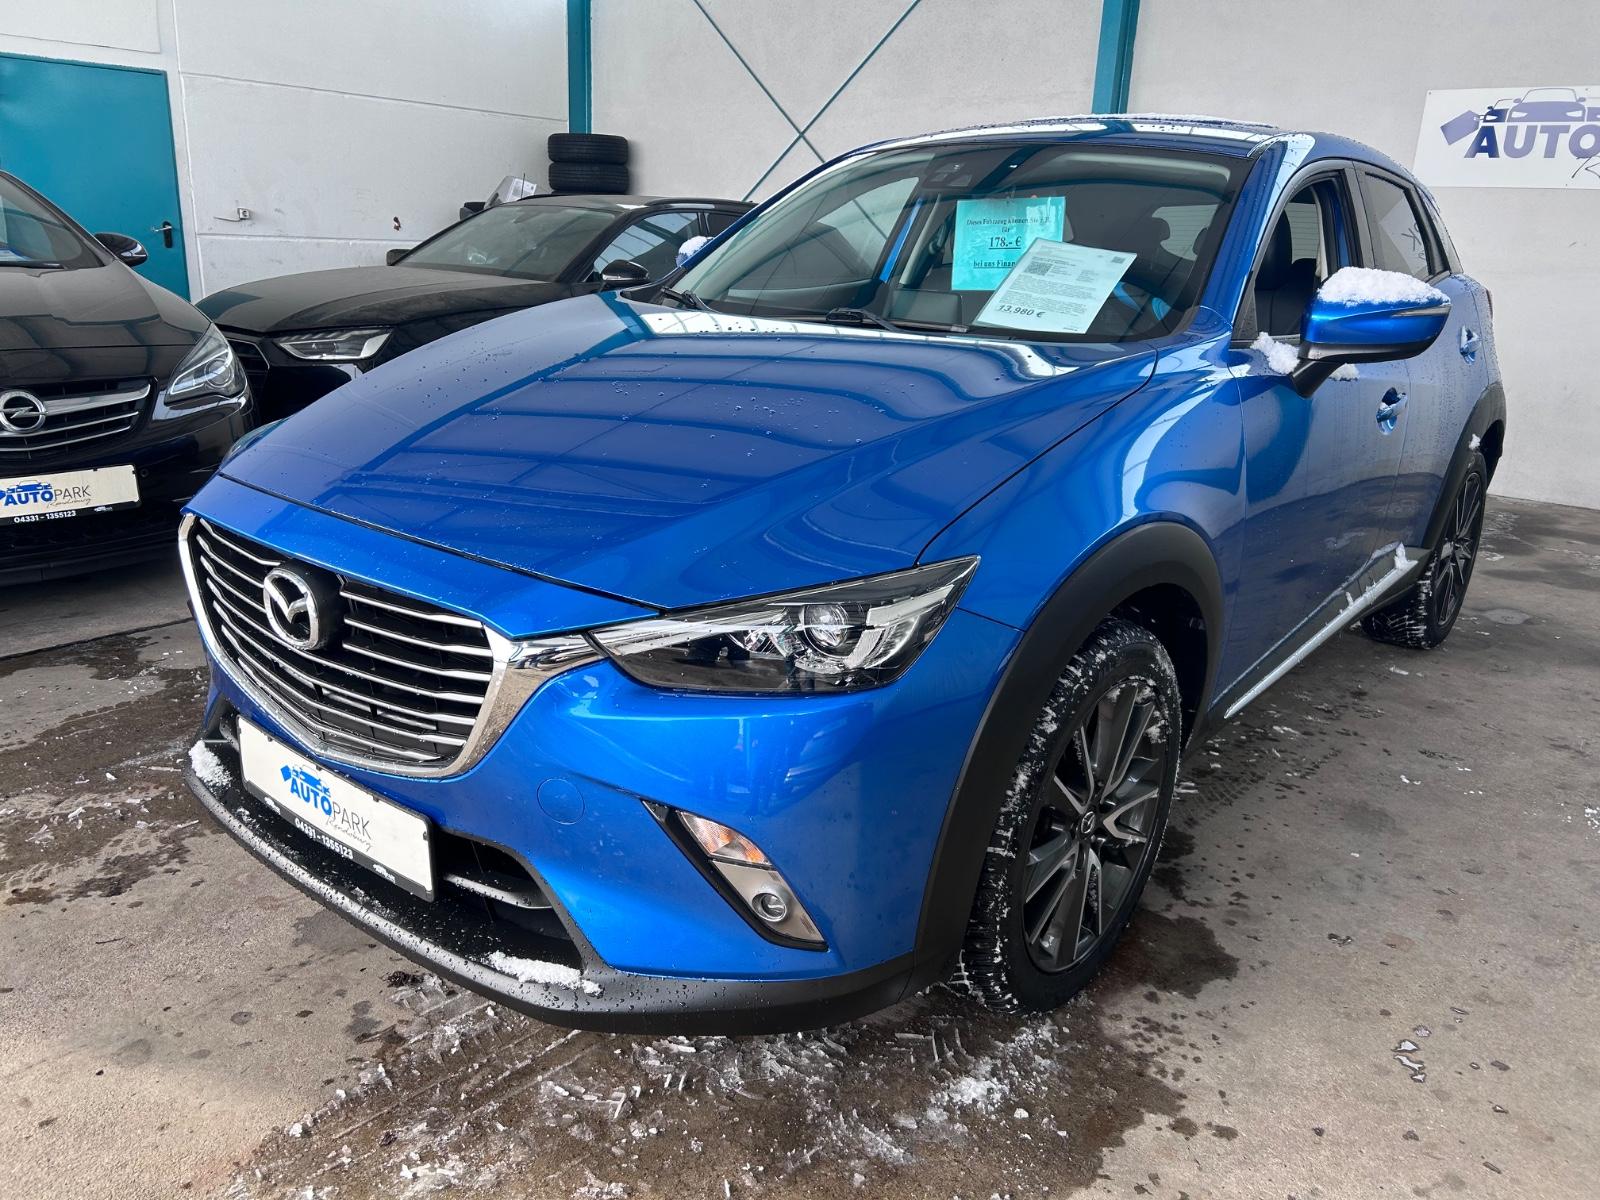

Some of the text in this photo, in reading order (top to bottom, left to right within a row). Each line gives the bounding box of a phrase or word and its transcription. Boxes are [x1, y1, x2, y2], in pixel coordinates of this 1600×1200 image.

[990, 236, 1022, 248] 178.- €
[973, 259, 983, 267] bei
[14, 514, 39, 523] 04331
[46, 510, 76, 520] 1355123
[294, 818, 316, 840] 04331
[322, 832, 353, 859] 1355123
